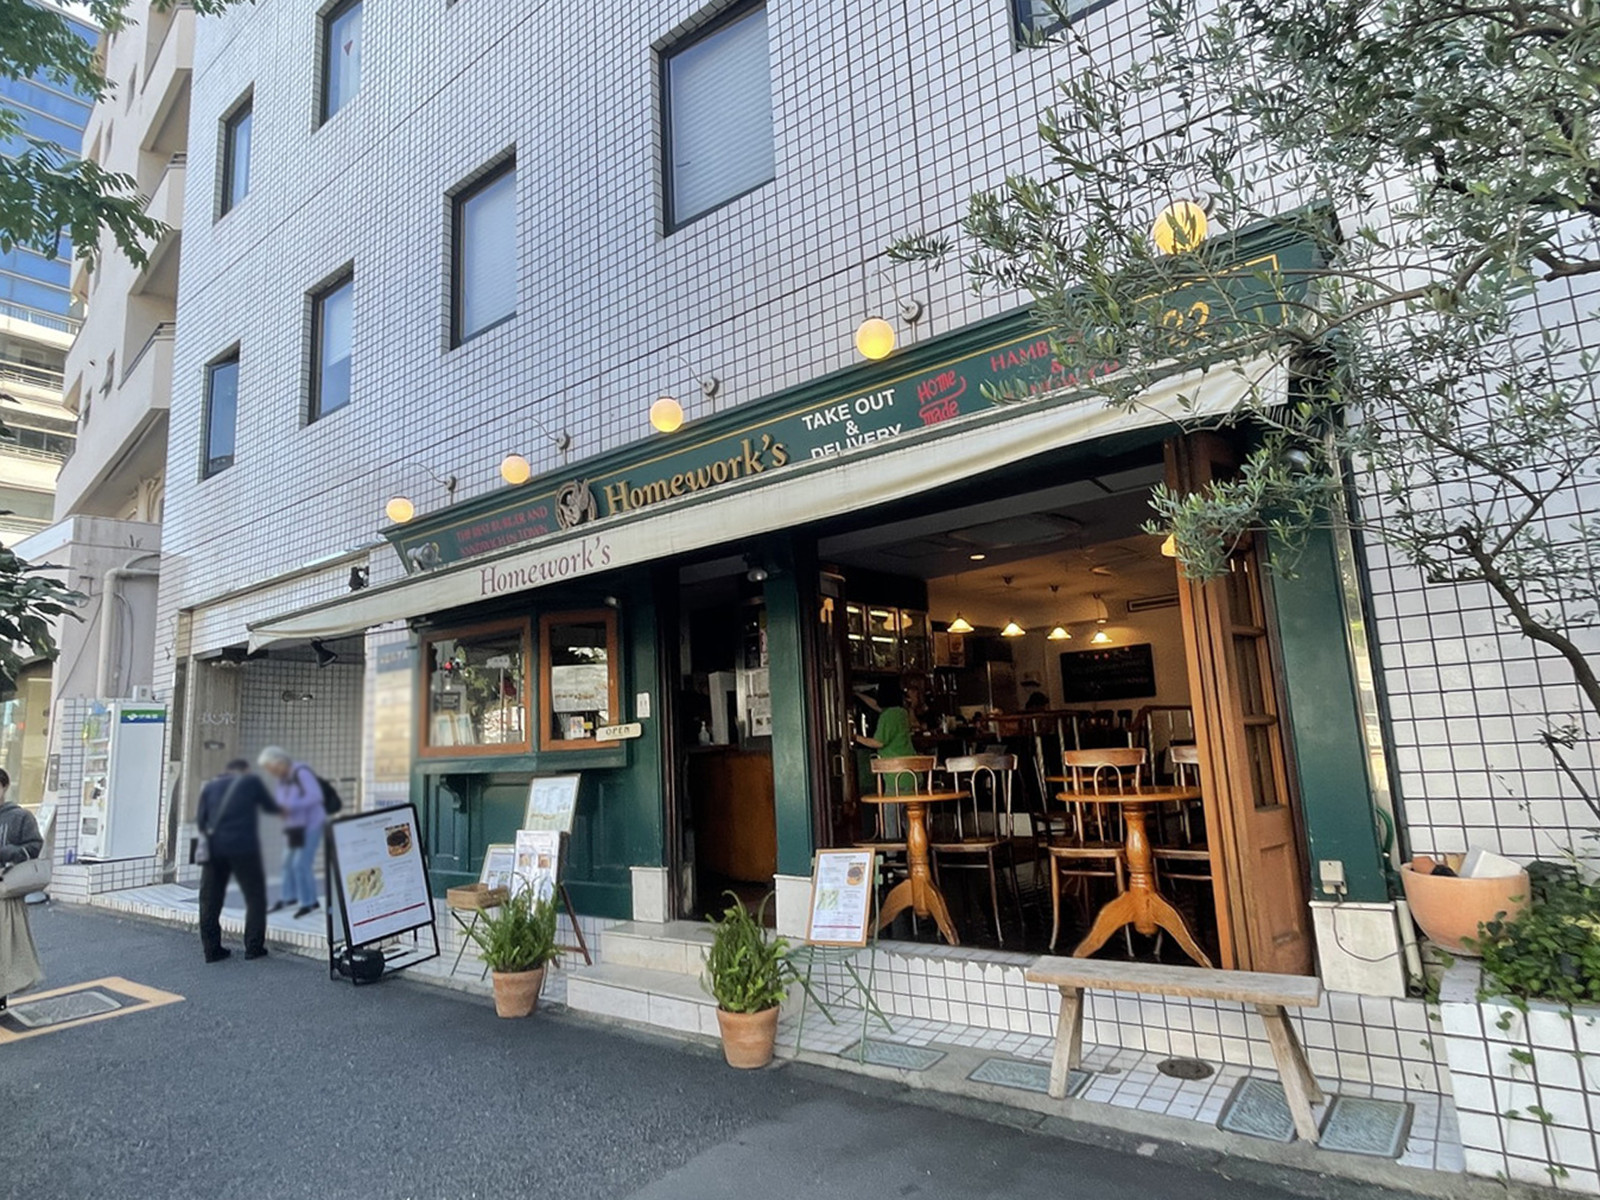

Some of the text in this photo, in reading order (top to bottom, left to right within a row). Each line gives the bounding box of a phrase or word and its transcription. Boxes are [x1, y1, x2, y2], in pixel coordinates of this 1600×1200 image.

[802, 389, 895, 431] TAKE OUT
[845, 420, 860, 436] &
[811, 423, 902, 459] DELIVERY
[603, 433, 789, 516] Homework's
[480, 536, 611, 596] Homework's
[605, 726, 630, 736] OPEN
